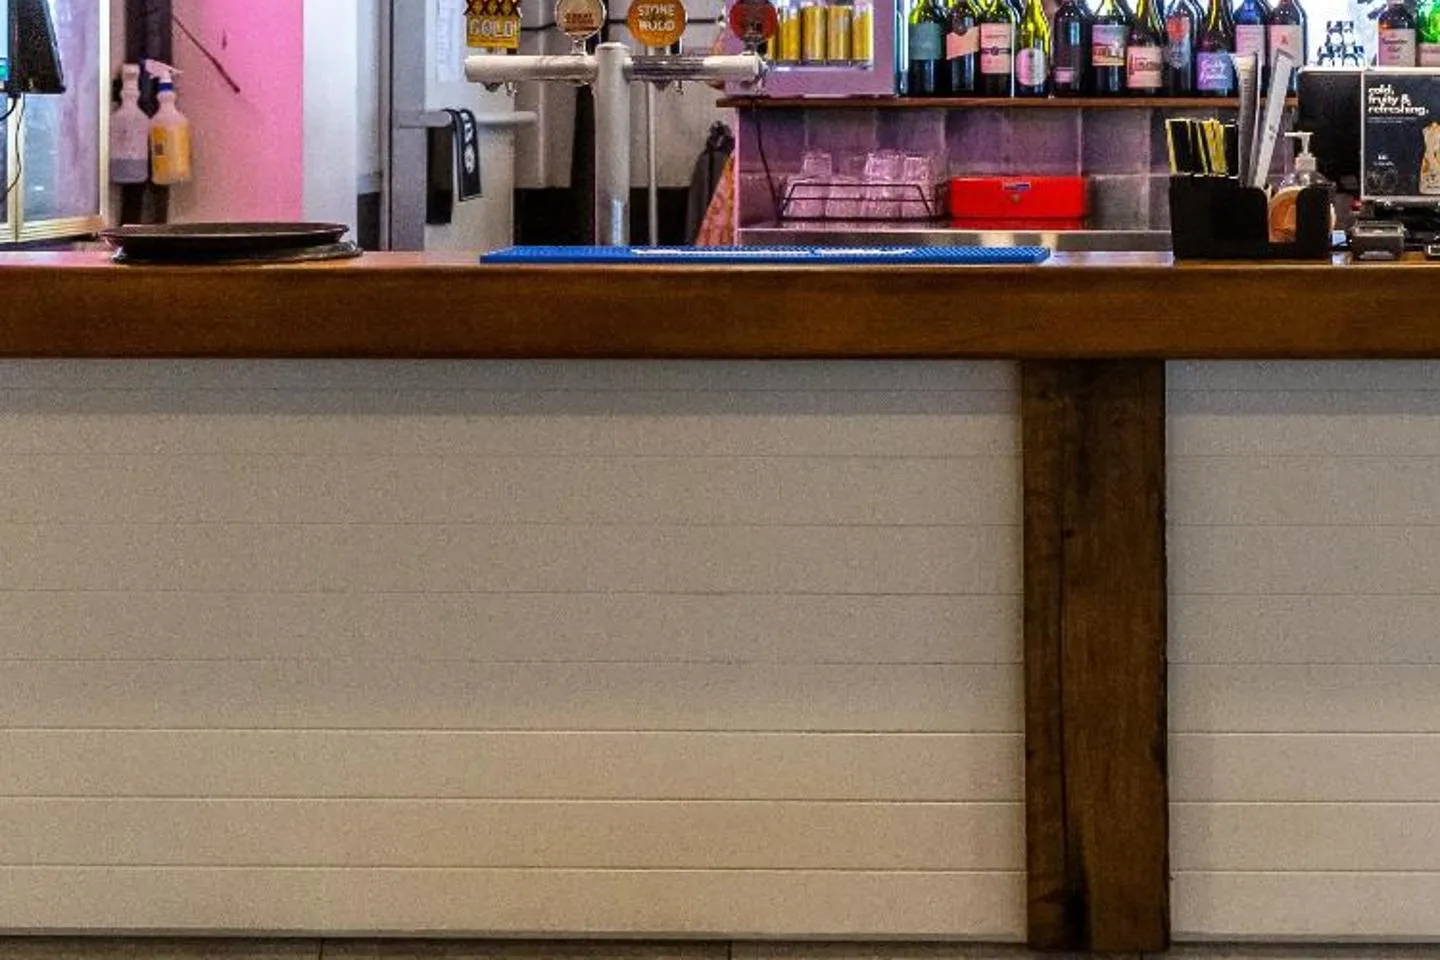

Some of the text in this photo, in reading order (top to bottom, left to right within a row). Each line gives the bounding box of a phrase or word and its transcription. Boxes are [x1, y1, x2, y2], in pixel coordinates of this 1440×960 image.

[469, 19, 515, 38] GOLD
[1368, 84, 1395, 96] cold,
[1401, 93, 1412, 106] &
[1368, 104, 1429, 117] refreshing.
